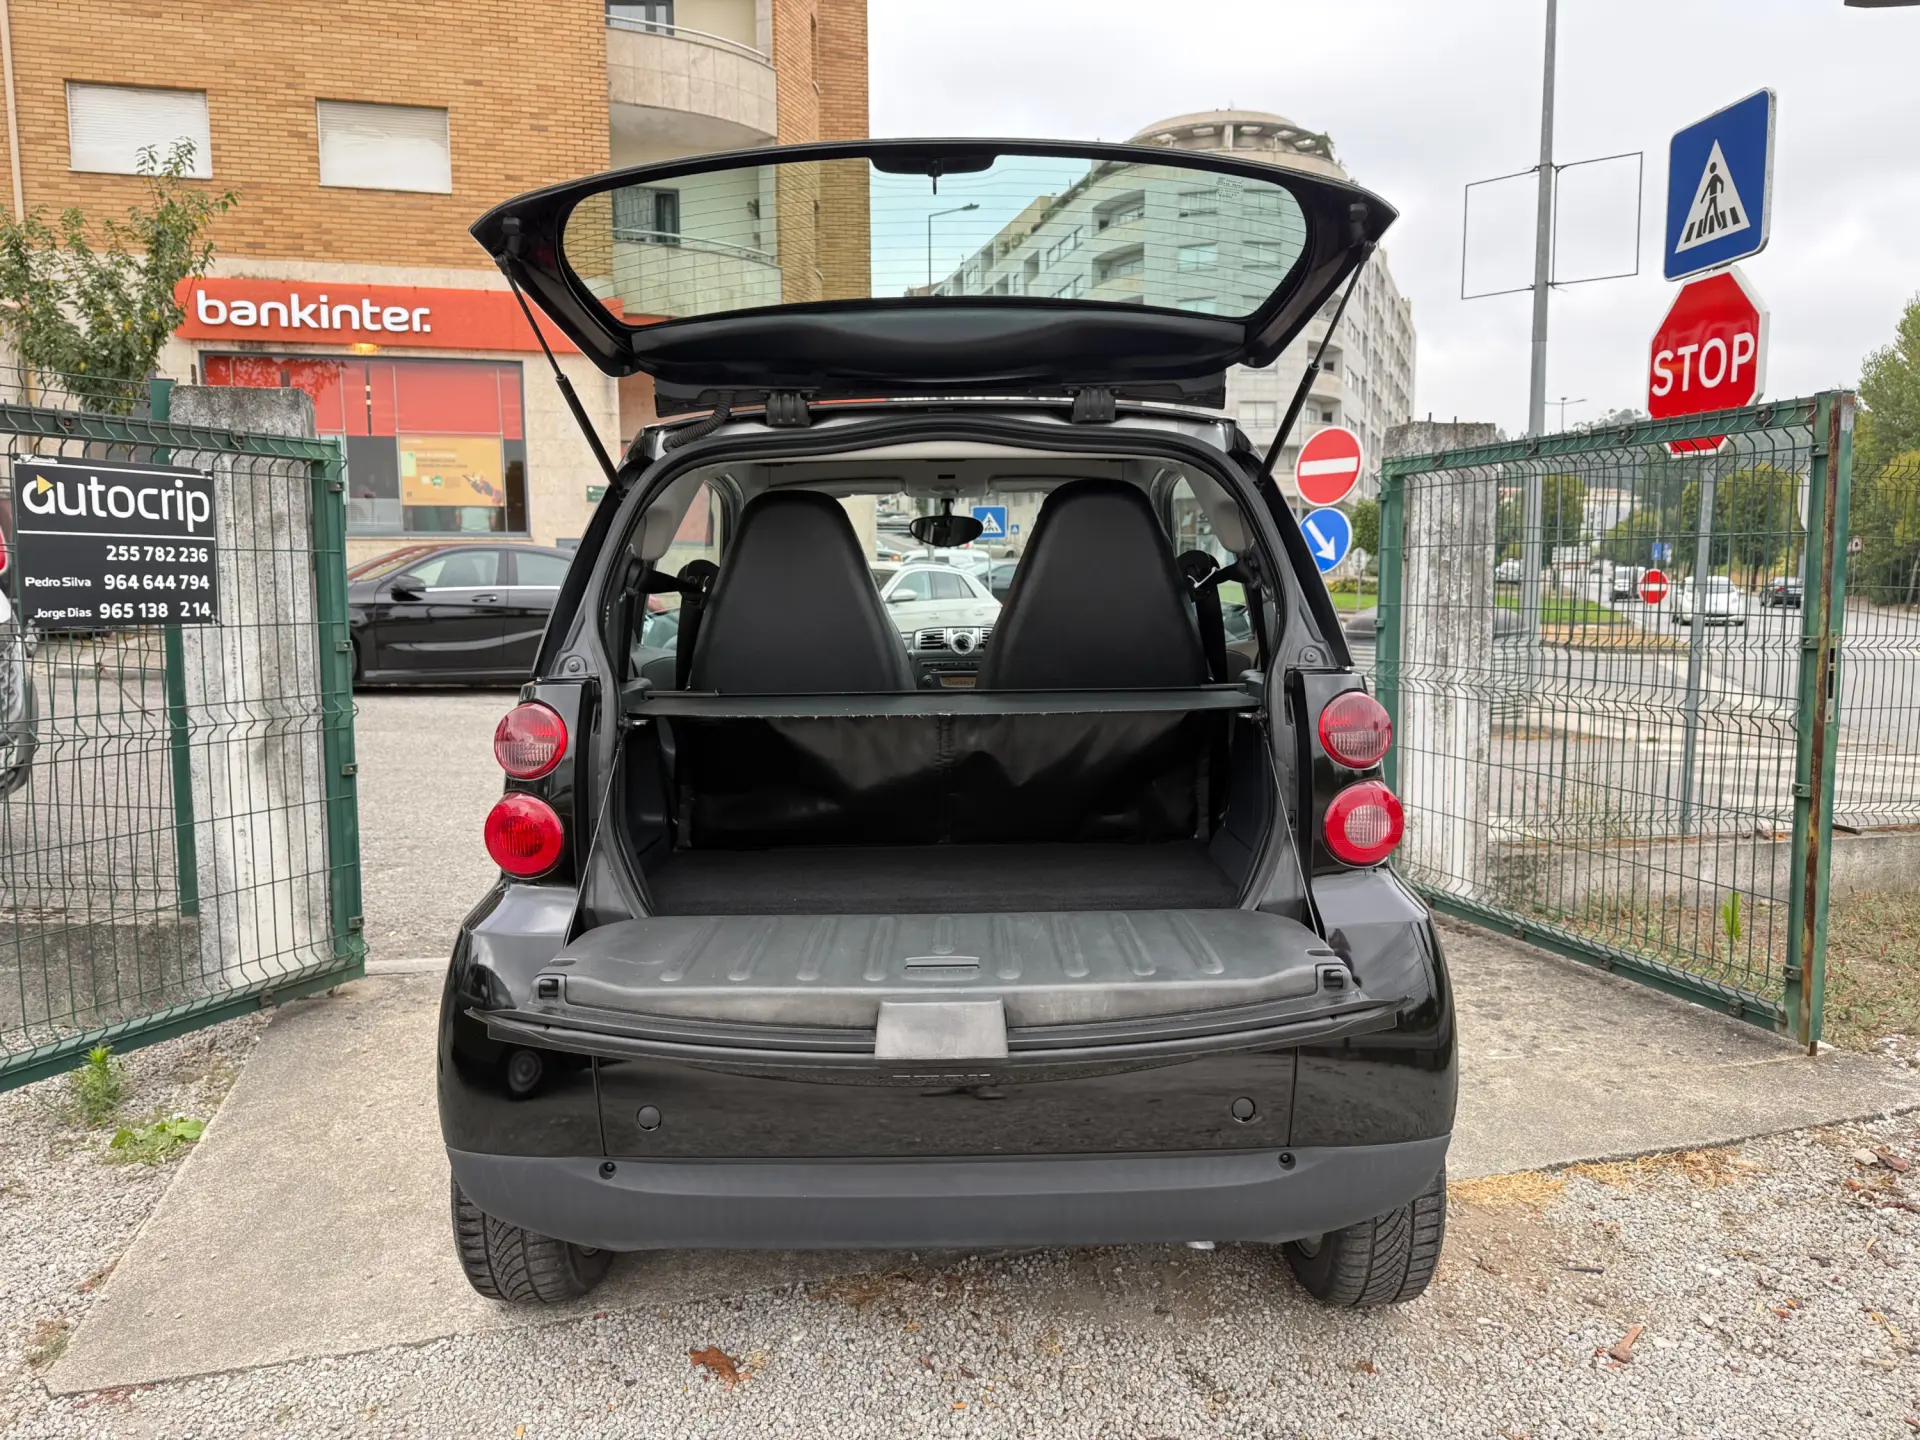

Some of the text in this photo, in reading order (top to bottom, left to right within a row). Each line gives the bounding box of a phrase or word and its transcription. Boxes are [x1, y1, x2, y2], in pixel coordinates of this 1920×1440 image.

[195, 289, 432, 334] bankinter.
[1651, 331, 1755, 397] STOP
[22, 475, 210, 533] autocrip
[106, 545, 209, 563] 255 782 236
[25, 574, 210, 590] Pedro Silva 964 644 794
[34, 602, 211, 621] Jorge Dias 965 138 214
